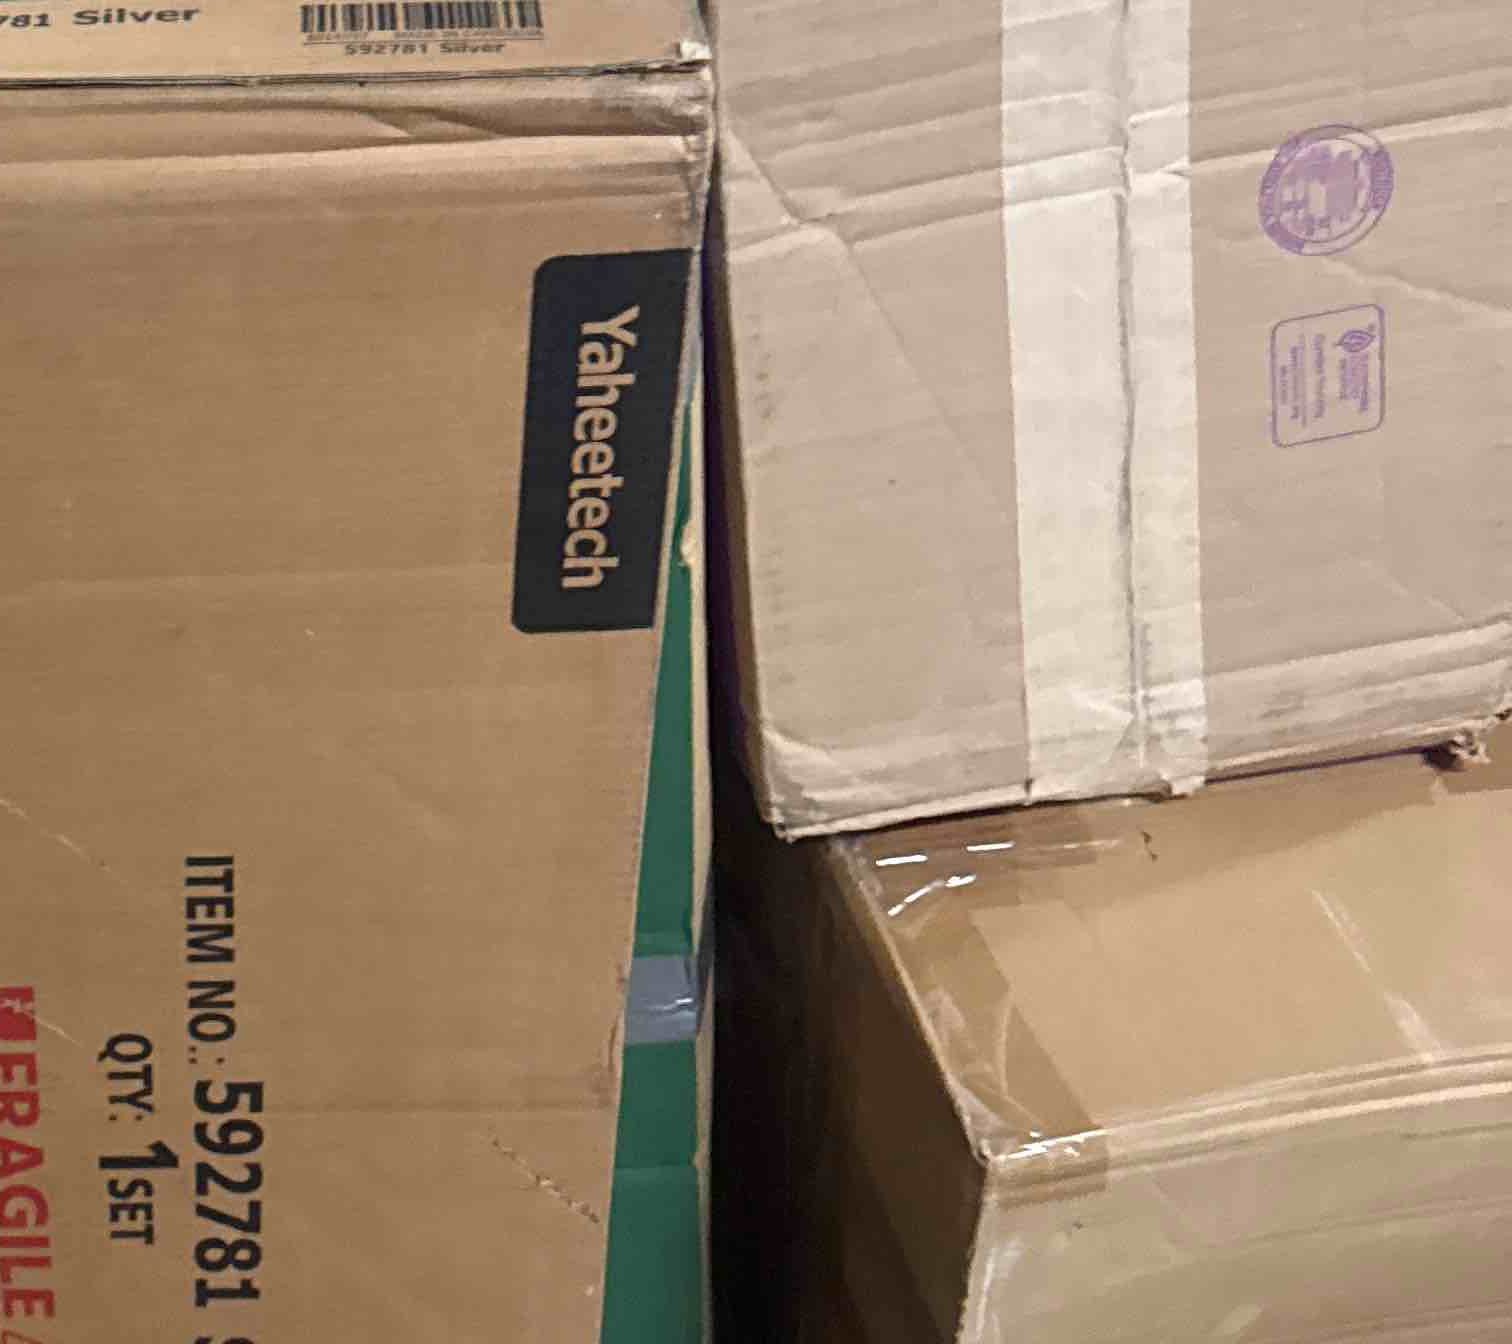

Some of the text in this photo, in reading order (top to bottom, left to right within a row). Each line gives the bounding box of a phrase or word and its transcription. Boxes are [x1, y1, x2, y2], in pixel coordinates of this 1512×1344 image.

[72, 6, 201, 27] Silver
[344, 41, 506, 56] 592781 Silver
[561, 304, 641, 591] Yaheetech
[185, 855, 237, 964] ITEM
[98, 1032, 156, 1122] QTY:
[193, 1078, 265, 1308] 592781
